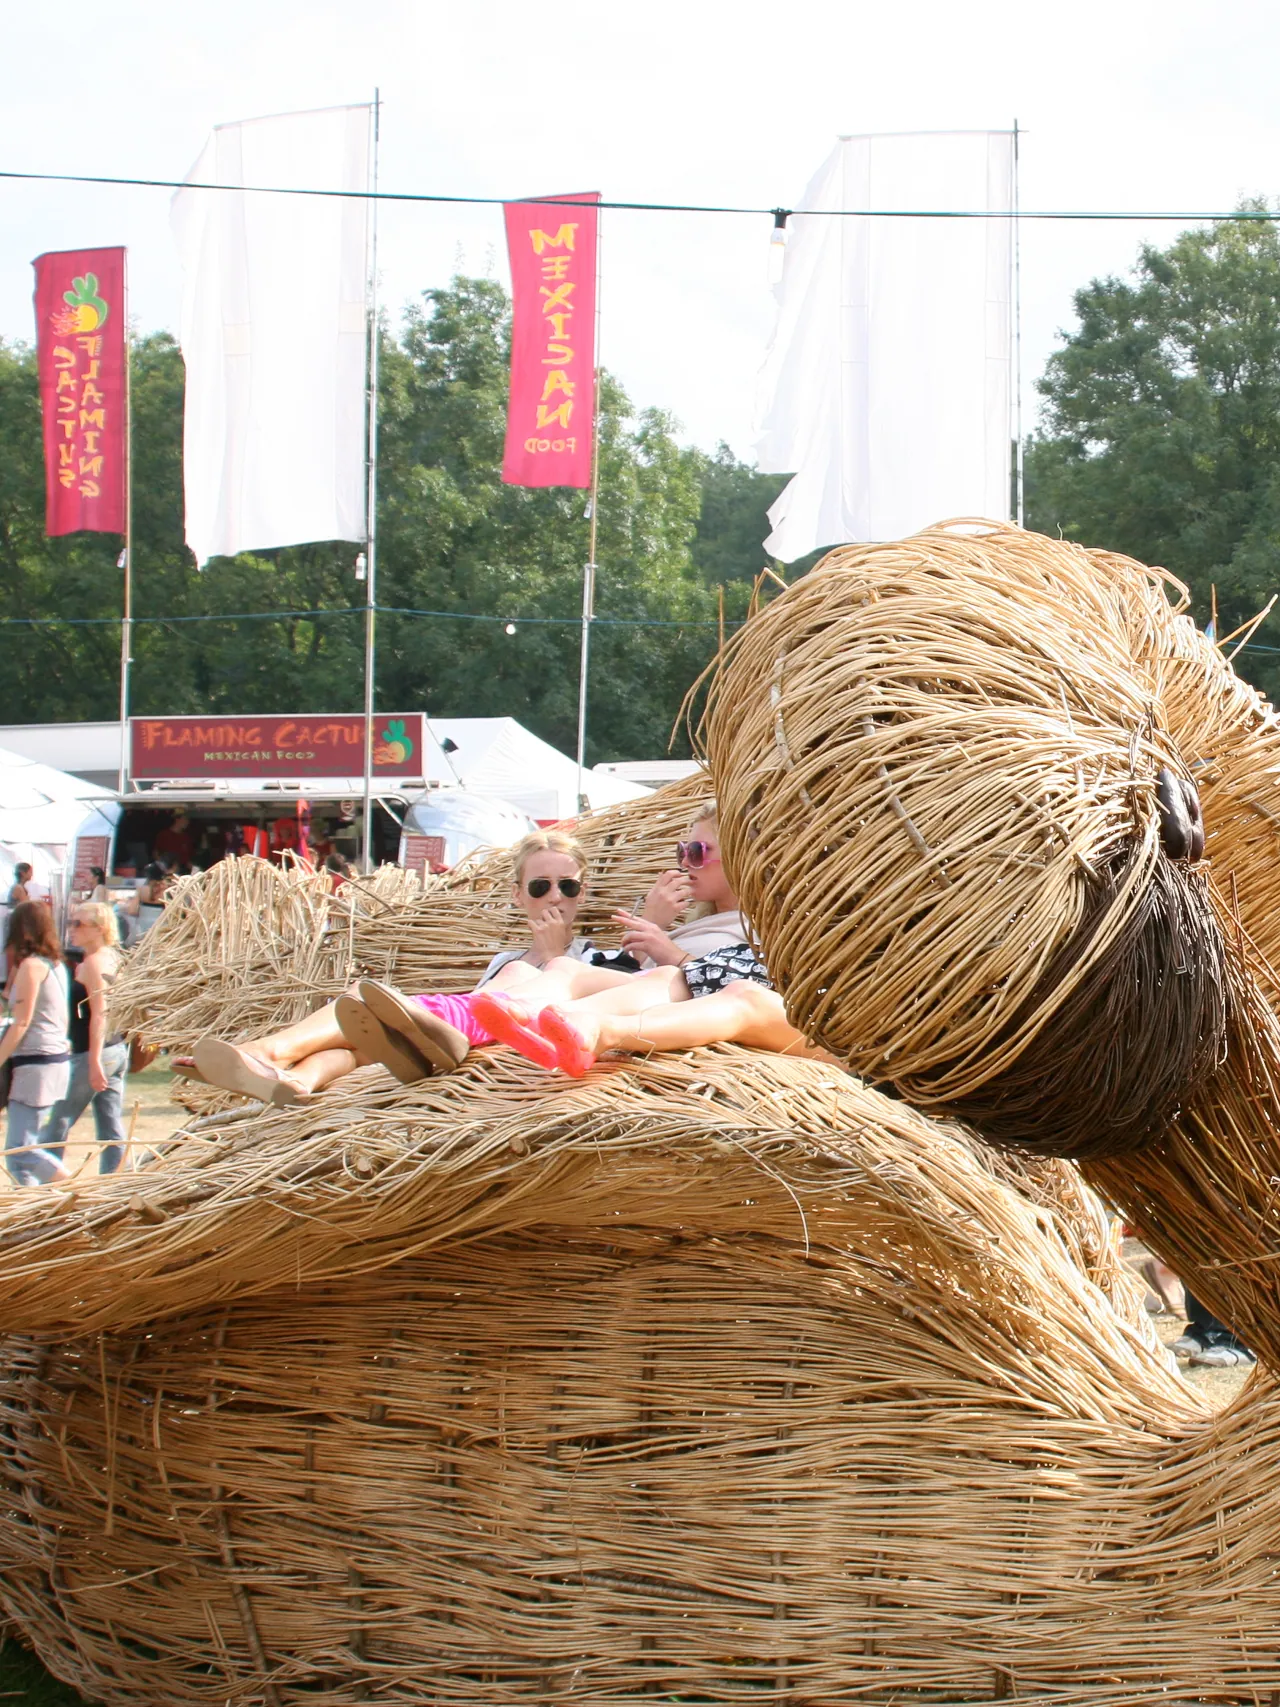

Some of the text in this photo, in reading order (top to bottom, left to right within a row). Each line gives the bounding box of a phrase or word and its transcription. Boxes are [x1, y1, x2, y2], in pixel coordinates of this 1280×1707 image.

[141, 720, 374, 749] FLAMING CACTU
[204, 750, 316, 762] MEXICAN FOOD
